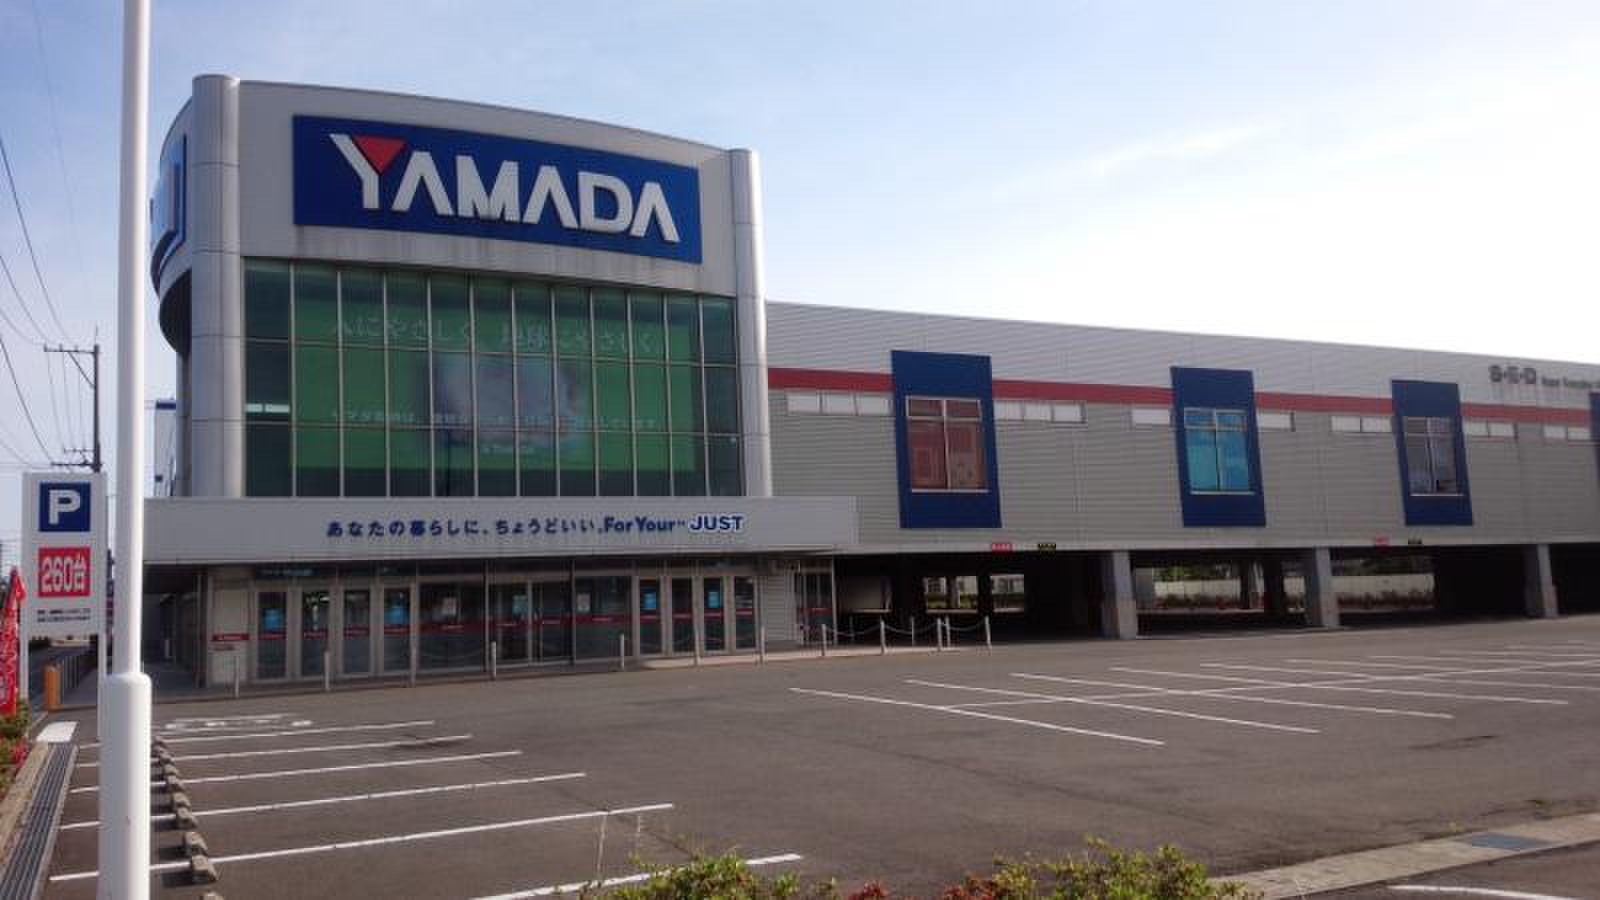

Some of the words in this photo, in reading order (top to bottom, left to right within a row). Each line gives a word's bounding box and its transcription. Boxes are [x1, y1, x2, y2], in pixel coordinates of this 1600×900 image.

[329, 133, 681, 243] YAMADA
[48, 489, 81, 525] P
[689, 514, 745, 533] JUST
[41, 555, 86, 592] 260台
